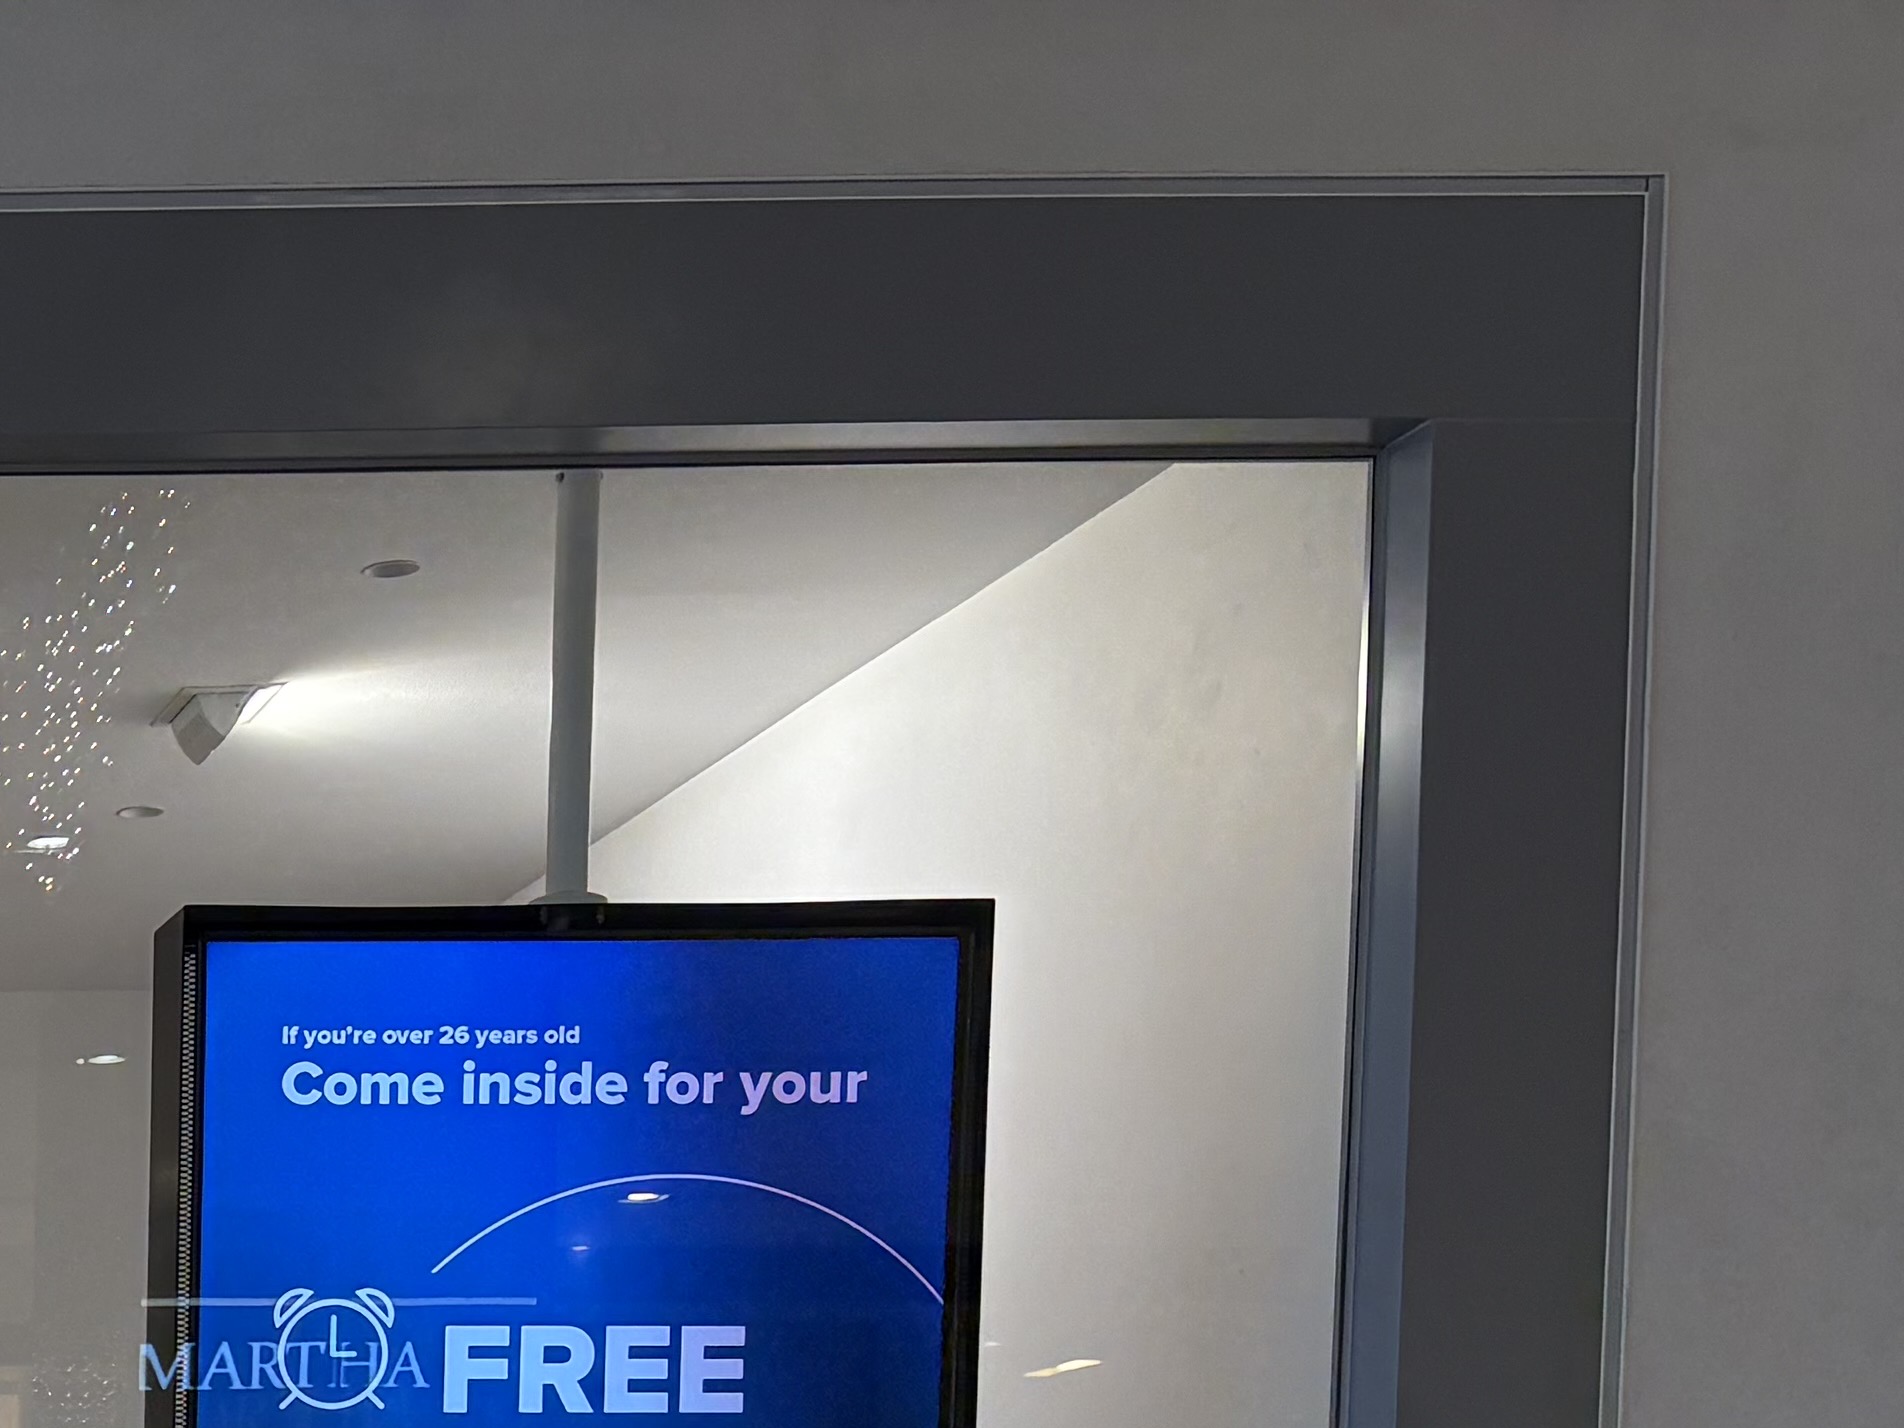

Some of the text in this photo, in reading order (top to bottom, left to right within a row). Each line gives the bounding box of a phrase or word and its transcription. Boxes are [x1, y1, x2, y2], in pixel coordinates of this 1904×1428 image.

[281, 1024, 581, 1051] If you're over 26 years old
[280, 1060, 868, 1116] Come inside for your
[138, 1341, 431, 1391] MARTHA
[442, 1325, 746, 1415] FREE
